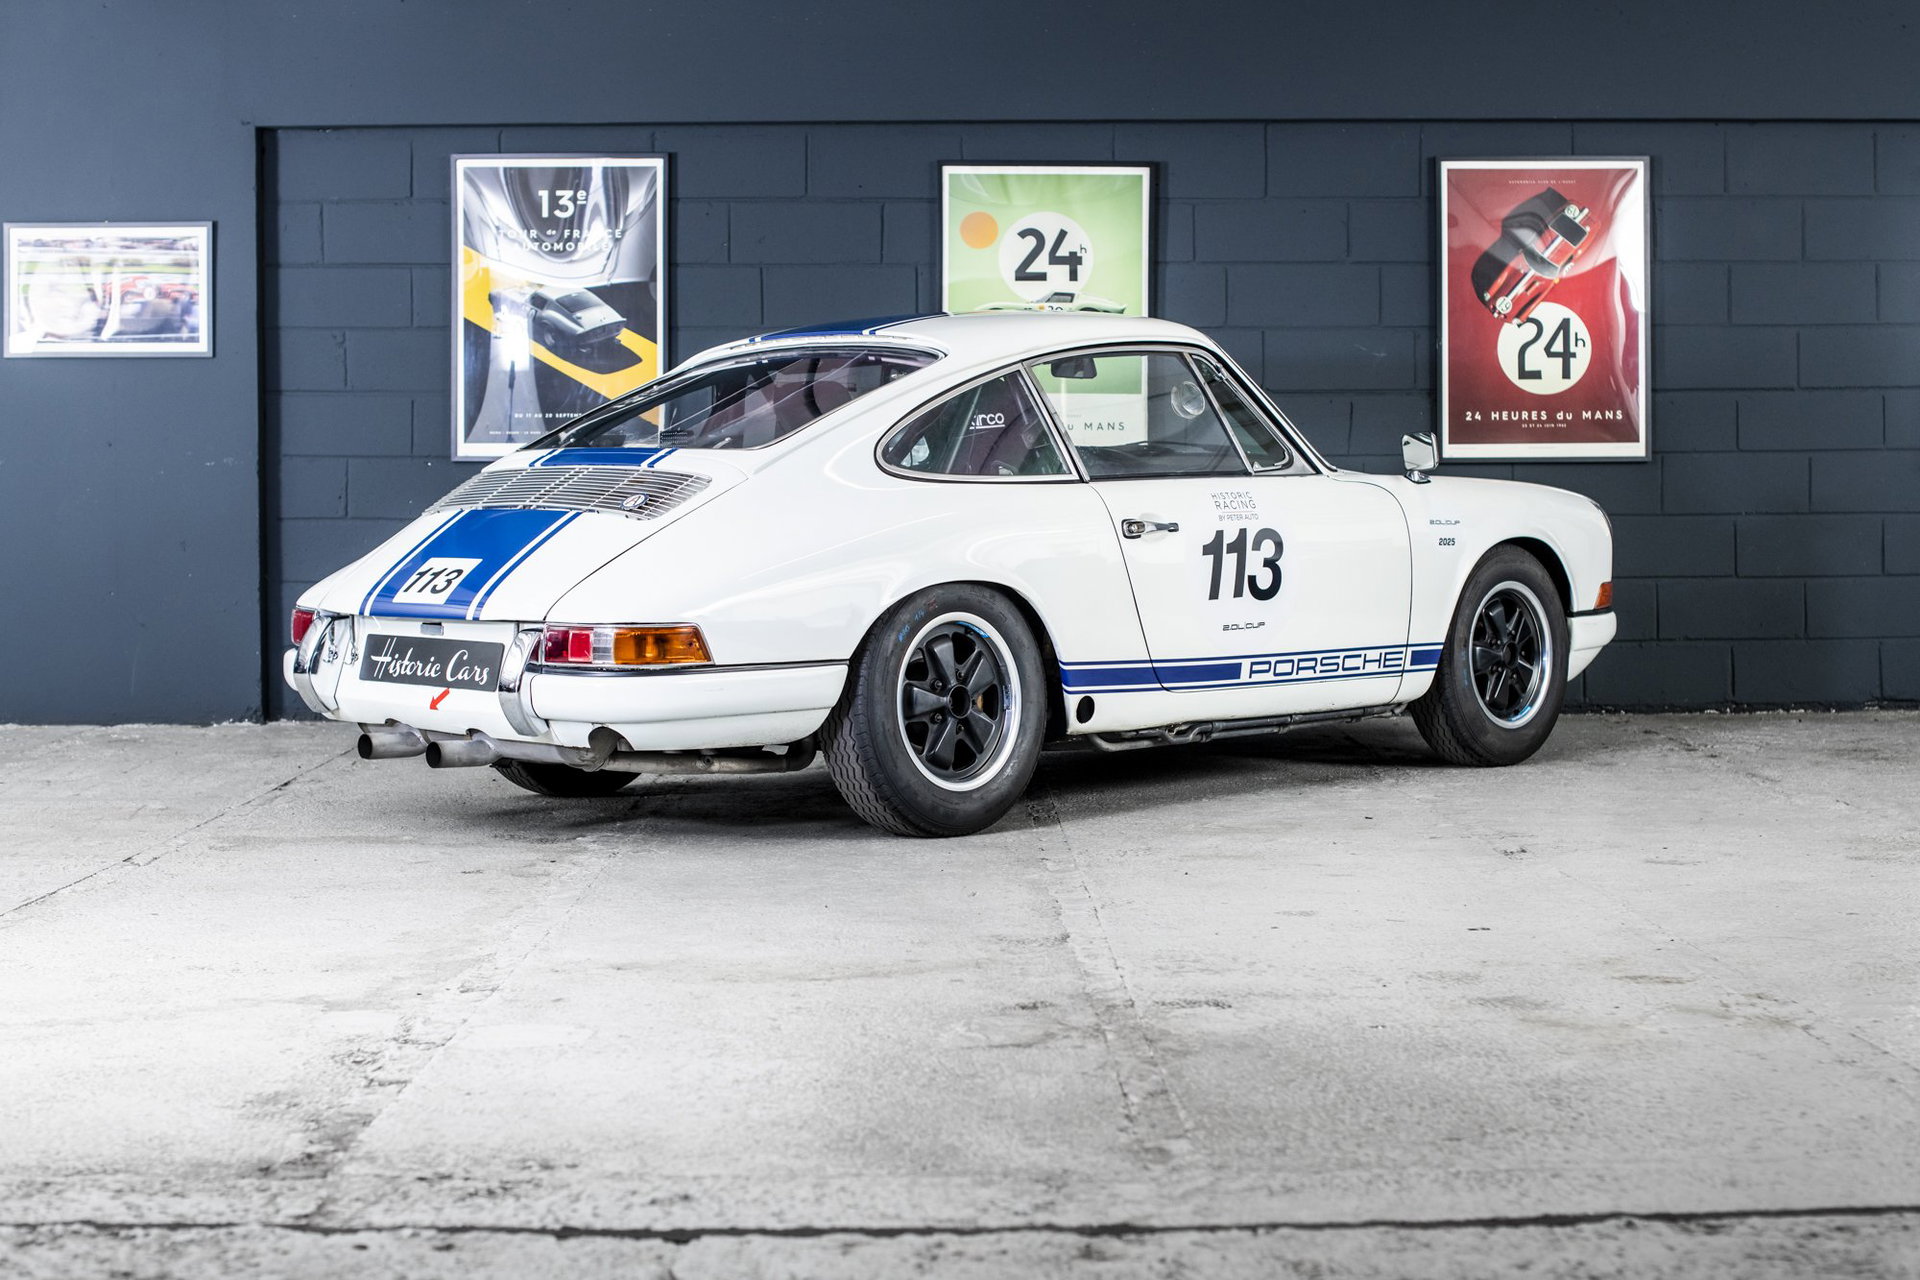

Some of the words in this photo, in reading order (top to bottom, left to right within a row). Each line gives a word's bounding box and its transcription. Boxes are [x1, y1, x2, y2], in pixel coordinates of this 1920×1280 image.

[1465, 411, 1482, 421] 24
[1491, 410, 1548, 421] HEURES
[1556, 410, 1573, 420] du
[1582, 410, 1623, 420] MANS
[1084, 421, 1126, 431] MANS
[1210, 491, 1252, 500] HISTORIC
[1214, 499, 1257, 510] RACING
[1438, 537, 1456, 546] 2025
[1202, 527, 1284, 601] 113
[403, 566, 464, 595] 113
[370, 637, 441, 679] Historic
[446, 649, 490, 685] Cars
[1249, 651, 1404, 679] PORSCHE
